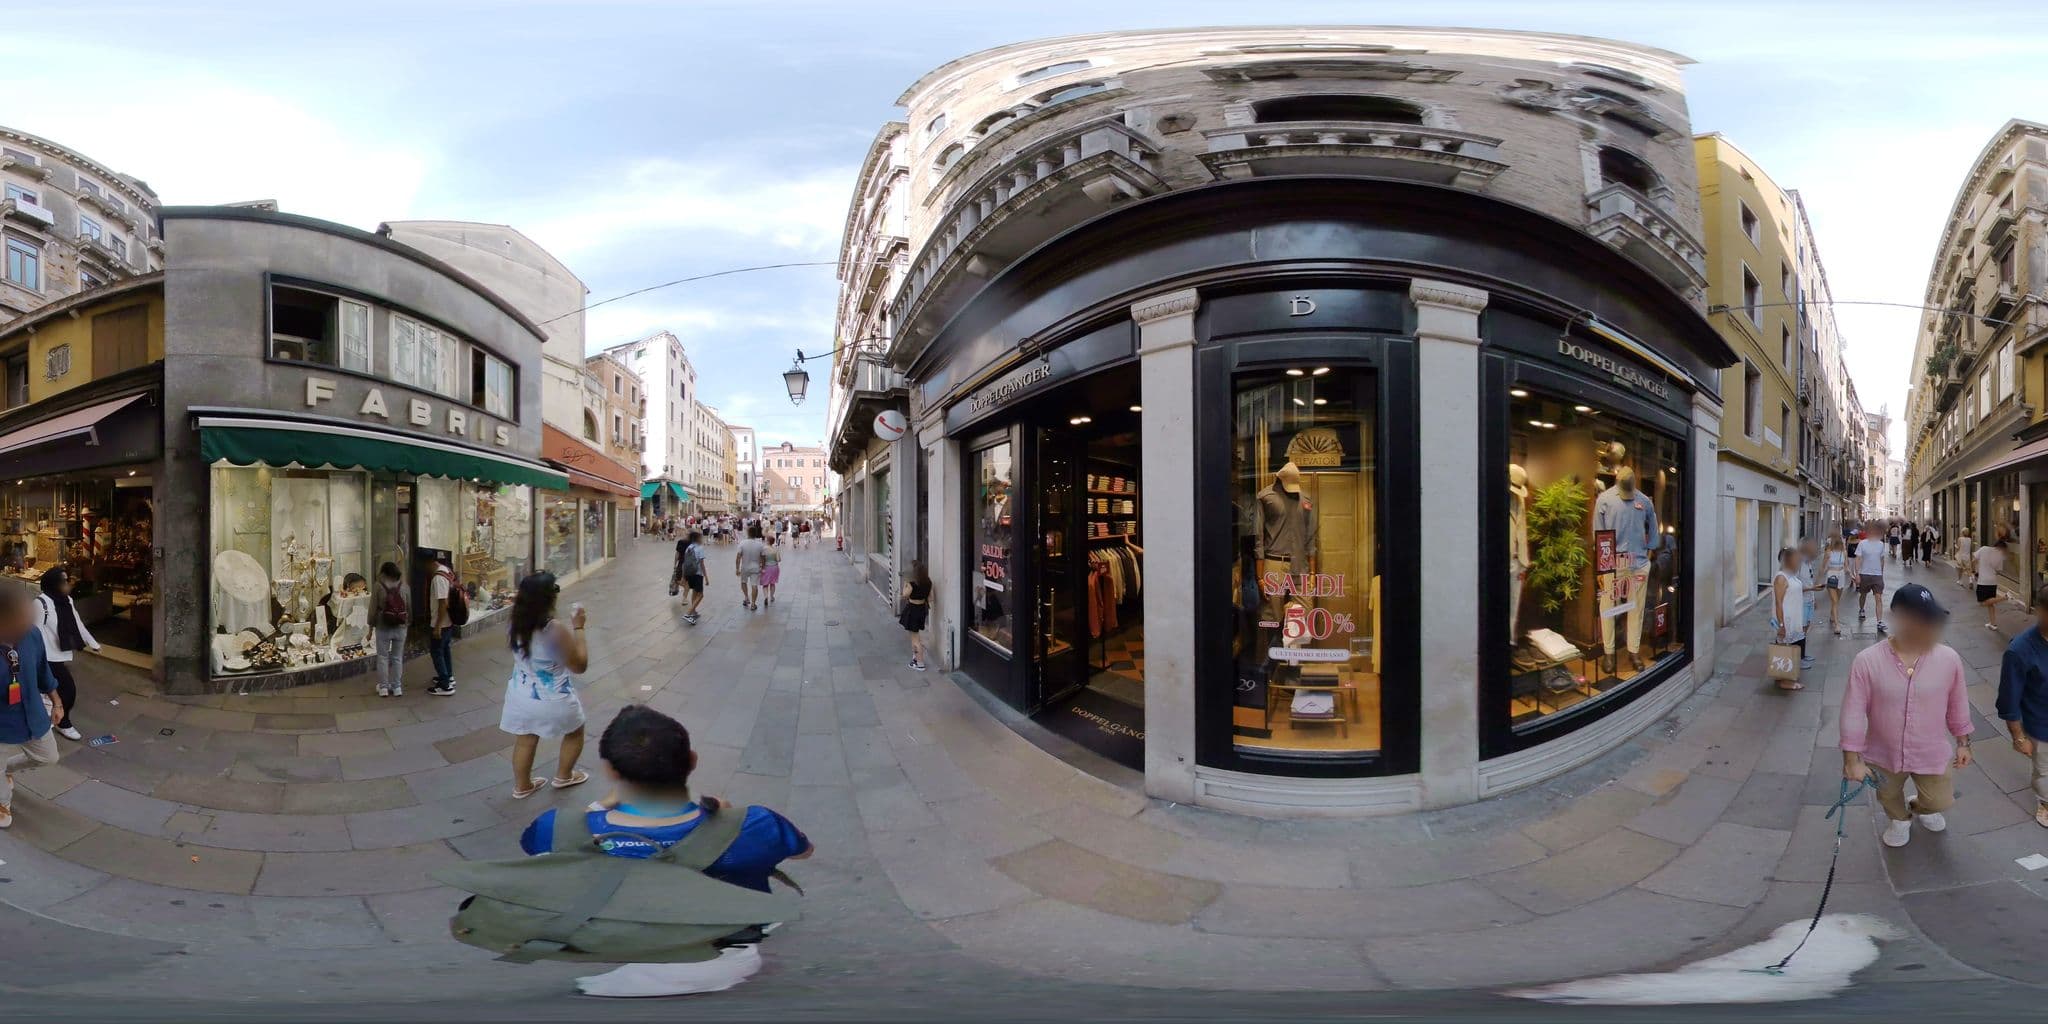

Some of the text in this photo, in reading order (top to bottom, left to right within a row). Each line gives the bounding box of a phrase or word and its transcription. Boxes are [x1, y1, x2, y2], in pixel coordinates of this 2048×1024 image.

[306, 376, 509, 446] FABRIS
[982, 544, 1004, 558] SALDI
[1263, 571, 1345, 597] SALDI
